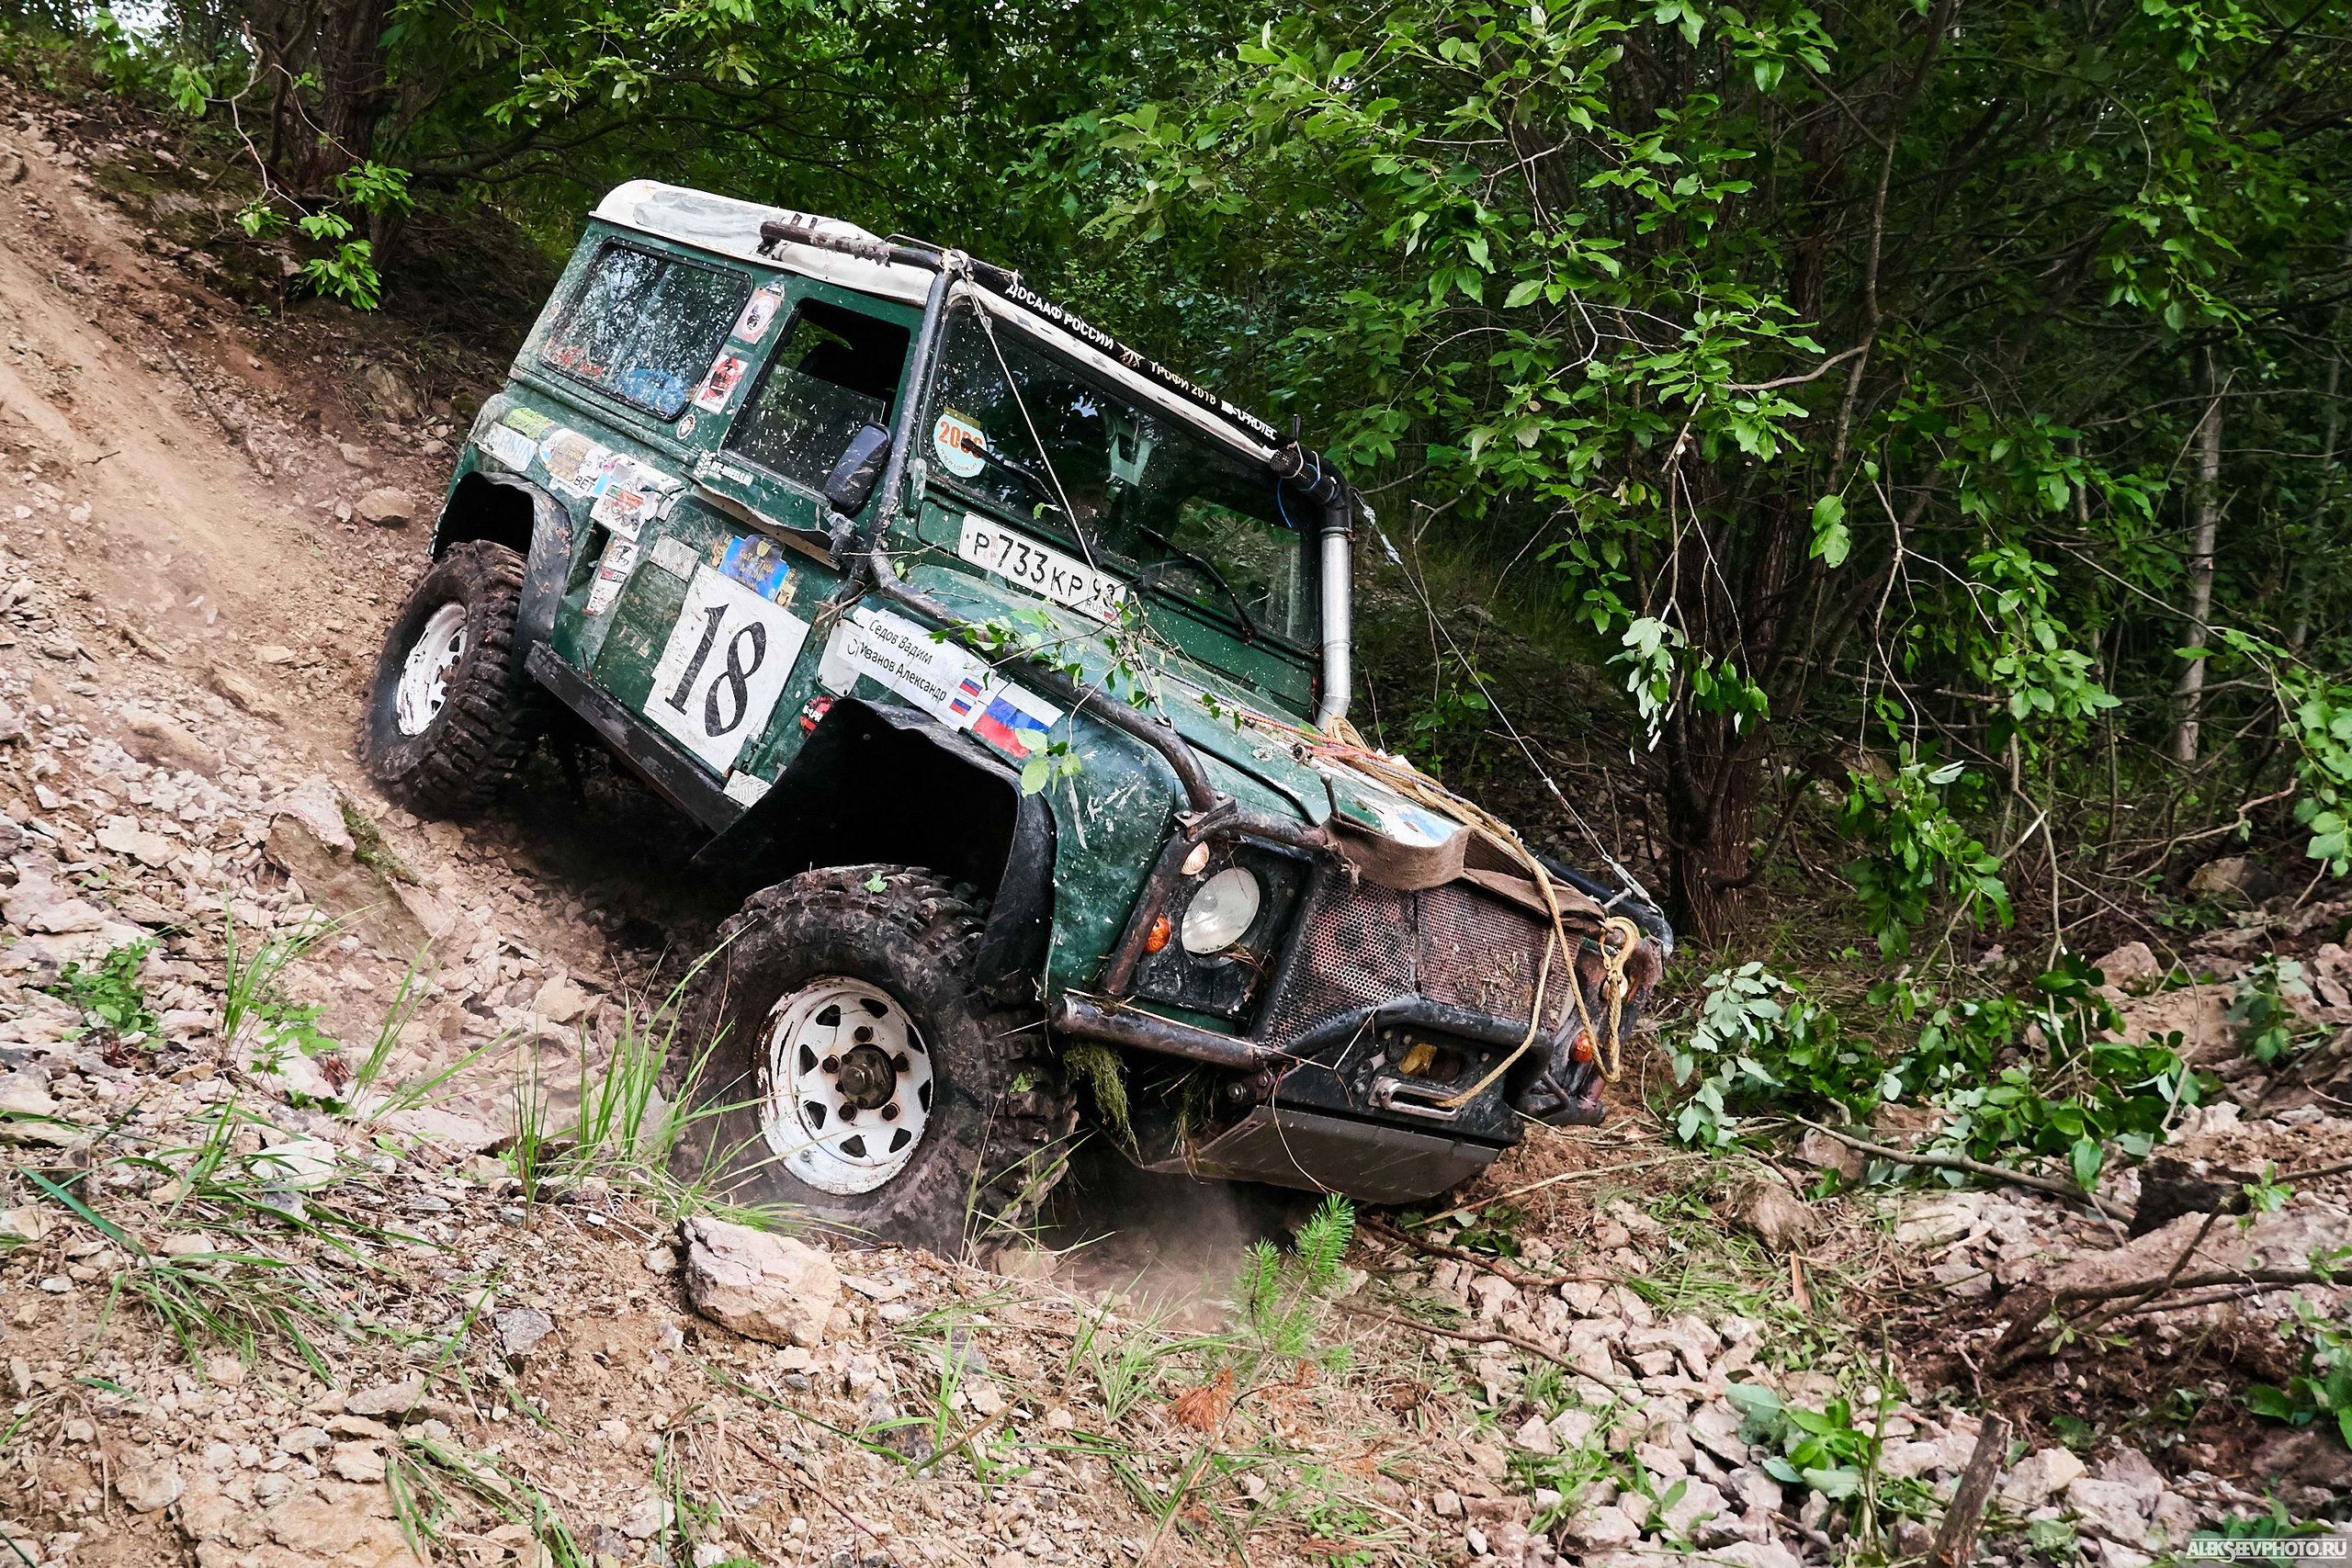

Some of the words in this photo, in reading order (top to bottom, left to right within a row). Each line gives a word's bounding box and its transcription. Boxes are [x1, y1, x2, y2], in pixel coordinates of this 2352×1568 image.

[1005, 284, 1062, 320] ДОСААФ
[1063, 313, 1114, 350] РОССИИ
[1149, 360, 1190, 391] ТРОФИ
[1191, 383, 1217, 405] 2018
[1086, 600, 1104, 615] RUS
[868, 619, 899, 645] Седов
[898, 637, 933, 665] Вадим
[664, 603, 767, 738] 18
[859, 641, 896, 672] Иванов
[895, 663, 947, 704] Александр
